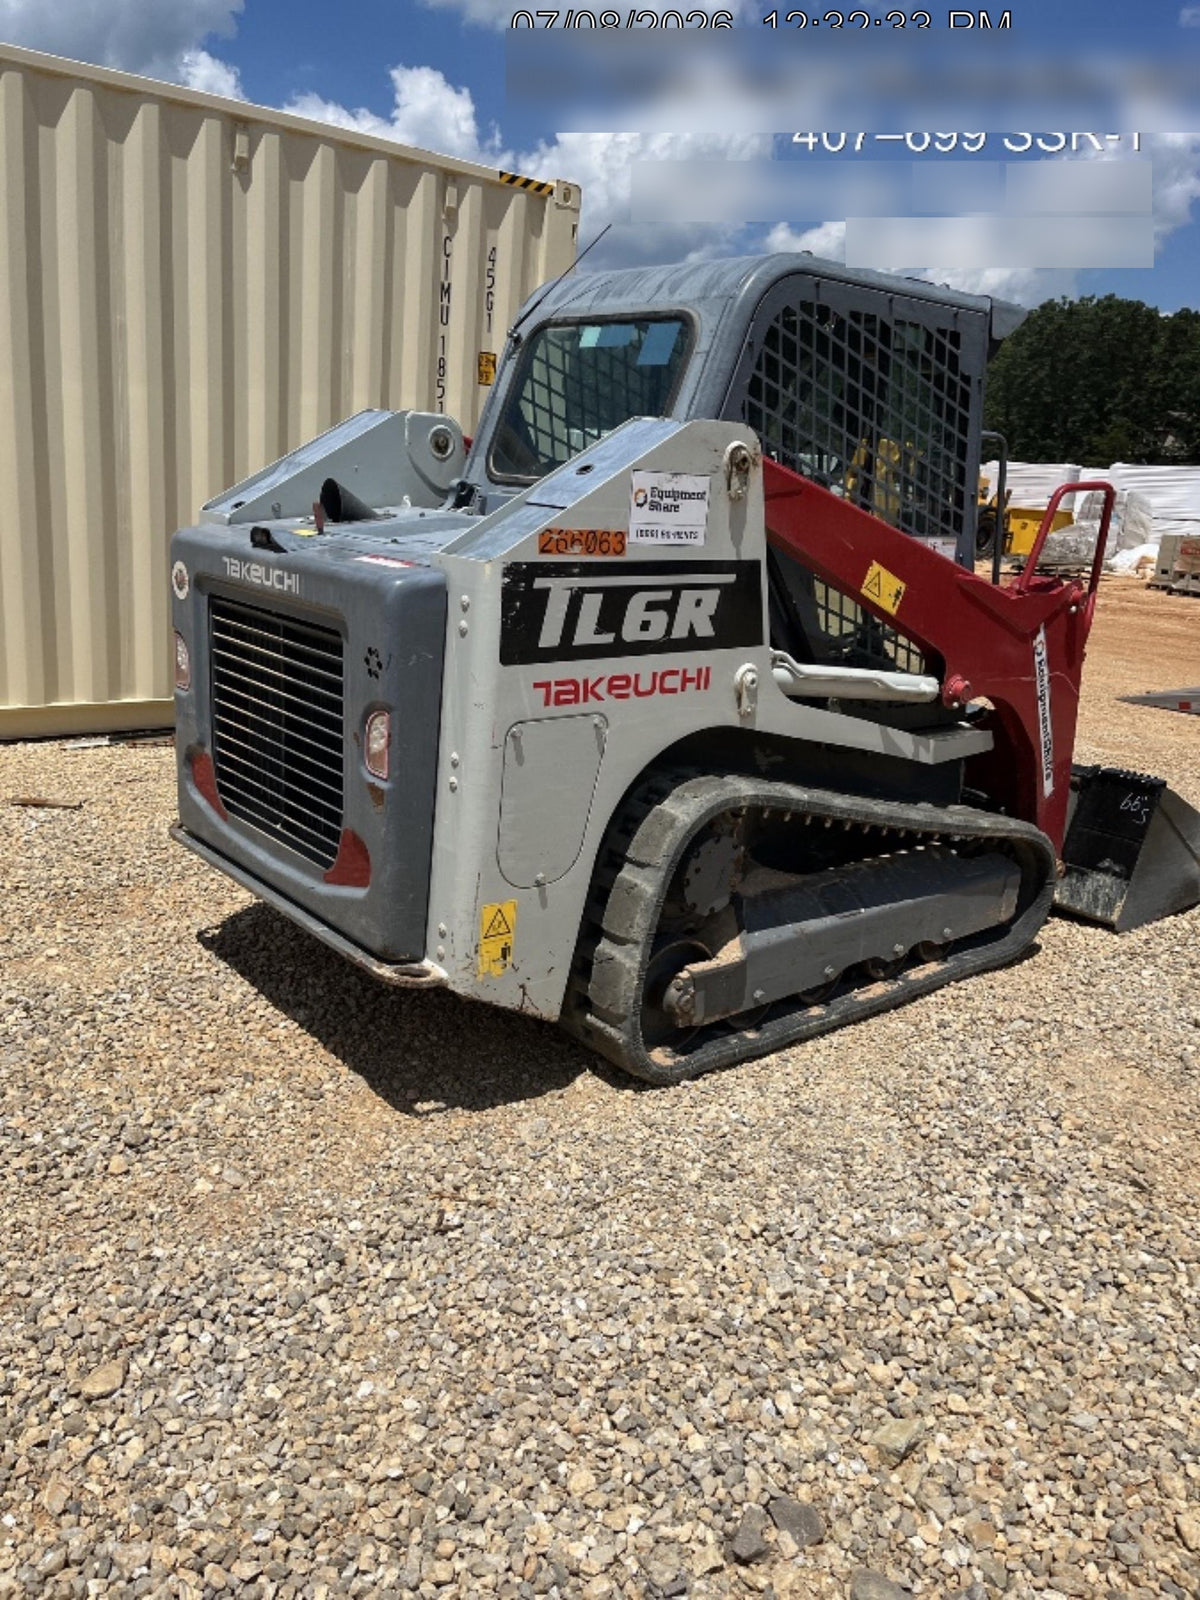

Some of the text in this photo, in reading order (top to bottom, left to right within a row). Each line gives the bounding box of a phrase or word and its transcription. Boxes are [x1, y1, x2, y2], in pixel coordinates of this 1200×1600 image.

[440, 236, 452, 326] CIMU
[648, 500, 680, 513] Share
[650, 486, 706, 501] Equipment
[533, 574, 736, 648] TL6R
